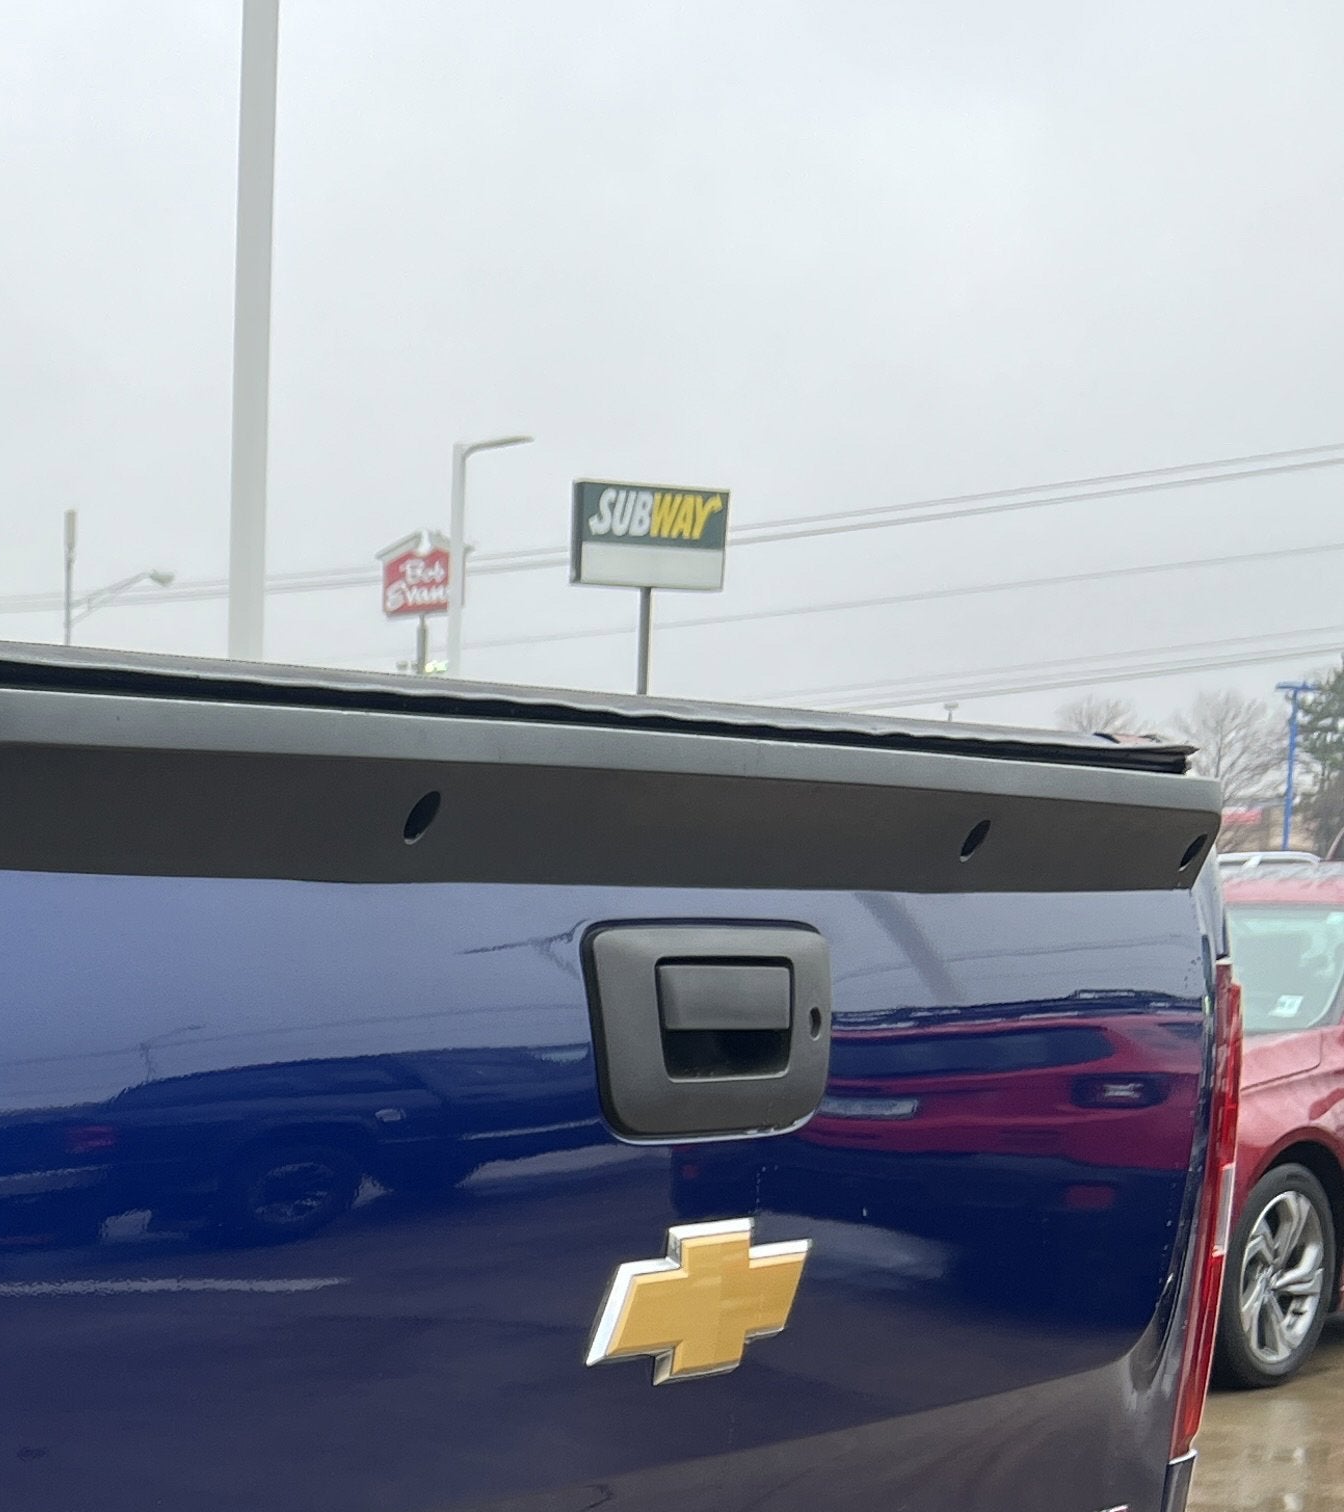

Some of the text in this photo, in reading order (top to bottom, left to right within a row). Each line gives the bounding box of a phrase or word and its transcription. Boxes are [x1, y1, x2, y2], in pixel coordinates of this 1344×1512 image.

[588, 487, 723, 540] SUBWAY
[399, 558, 445, 585] Bob
[385, 580, 449, 612] Evan
